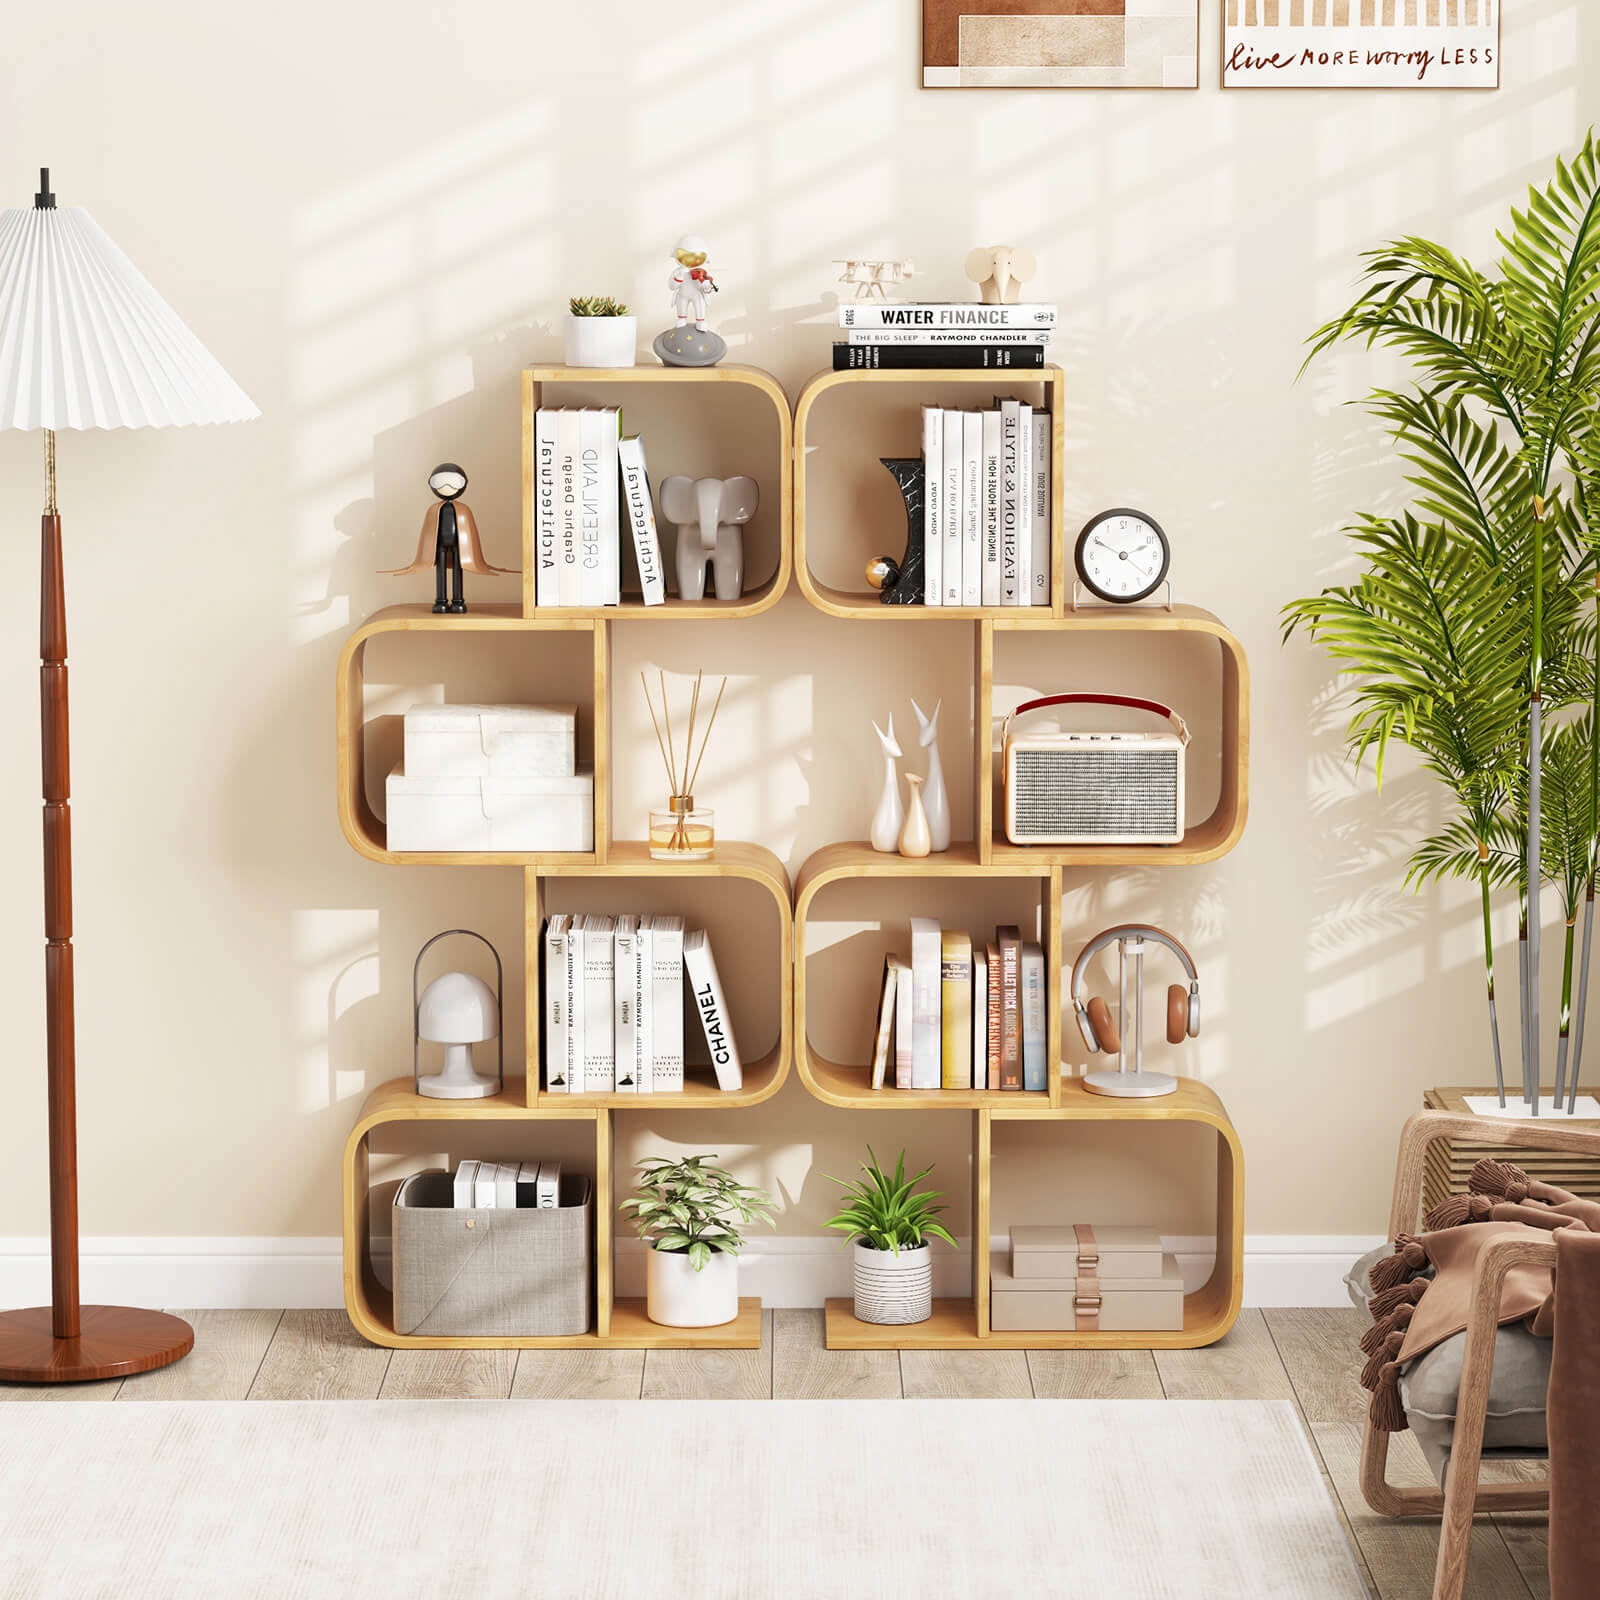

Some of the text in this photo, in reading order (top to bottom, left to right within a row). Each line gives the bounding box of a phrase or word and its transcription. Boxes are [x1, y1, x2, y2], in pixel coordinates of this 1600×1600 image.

[1224, 42, 1493, 80] live MORE worry LESS
[881, 310, 1009, 325] WATER FINANCE
[855, 334, 1028, 342] THE BIG SLEEP RAYMOND CHANDLER
[1004, 946, 1016, 961] THE
[1004, 962, 1016, 987] BULLET
[1004, 988, 1016, 1010] TRICK
[699, 983, 730, 1065] CHANEL
